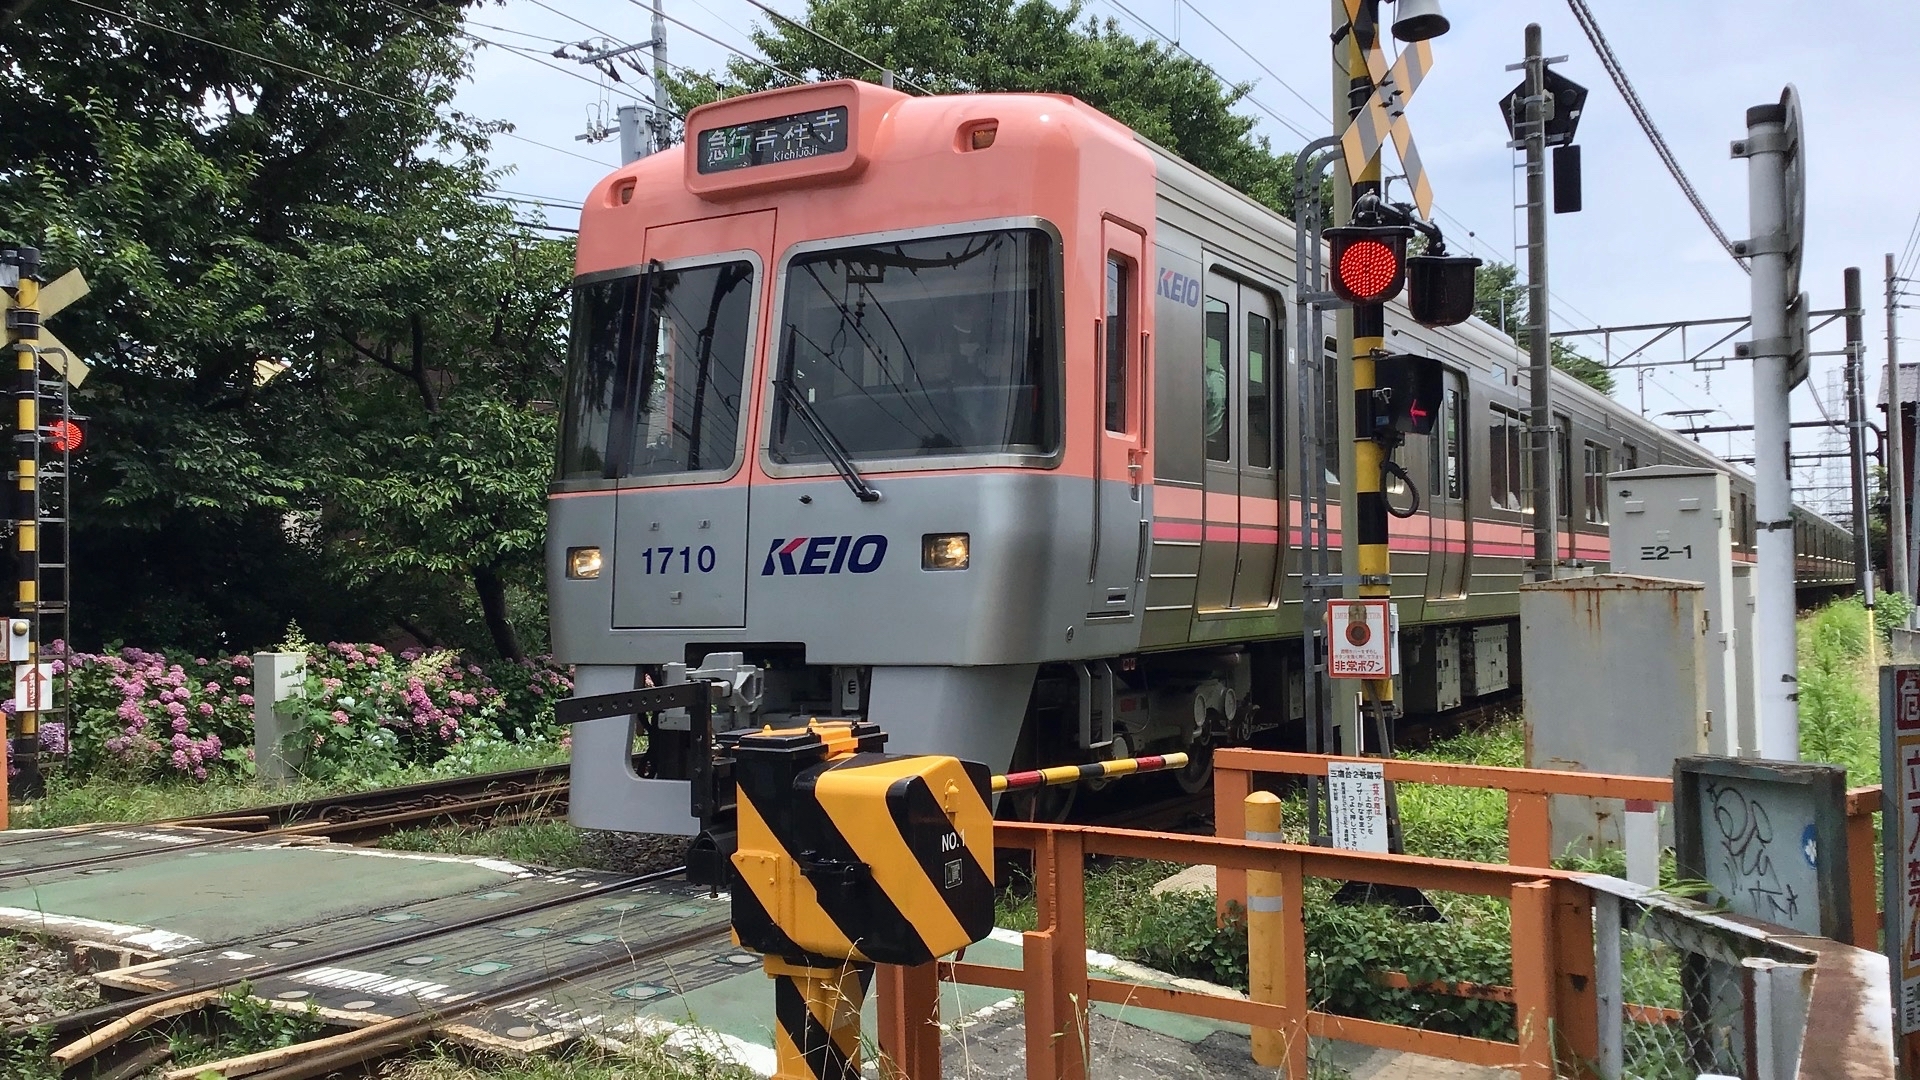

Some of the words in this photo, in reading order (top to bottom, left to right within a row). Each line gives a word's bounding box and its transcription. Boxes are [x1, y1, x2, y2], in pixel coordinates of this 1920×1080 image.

[708, 126, 751, 163] 急行
[1156, 267, 1200, 308] KEIO
[642, 544, 716, 576] 1710
[762, 533, 888, 577] KEIO
[1335, 660, 1384, 672] 非常ボタン
[942, 828, 965, 853] NO.1
